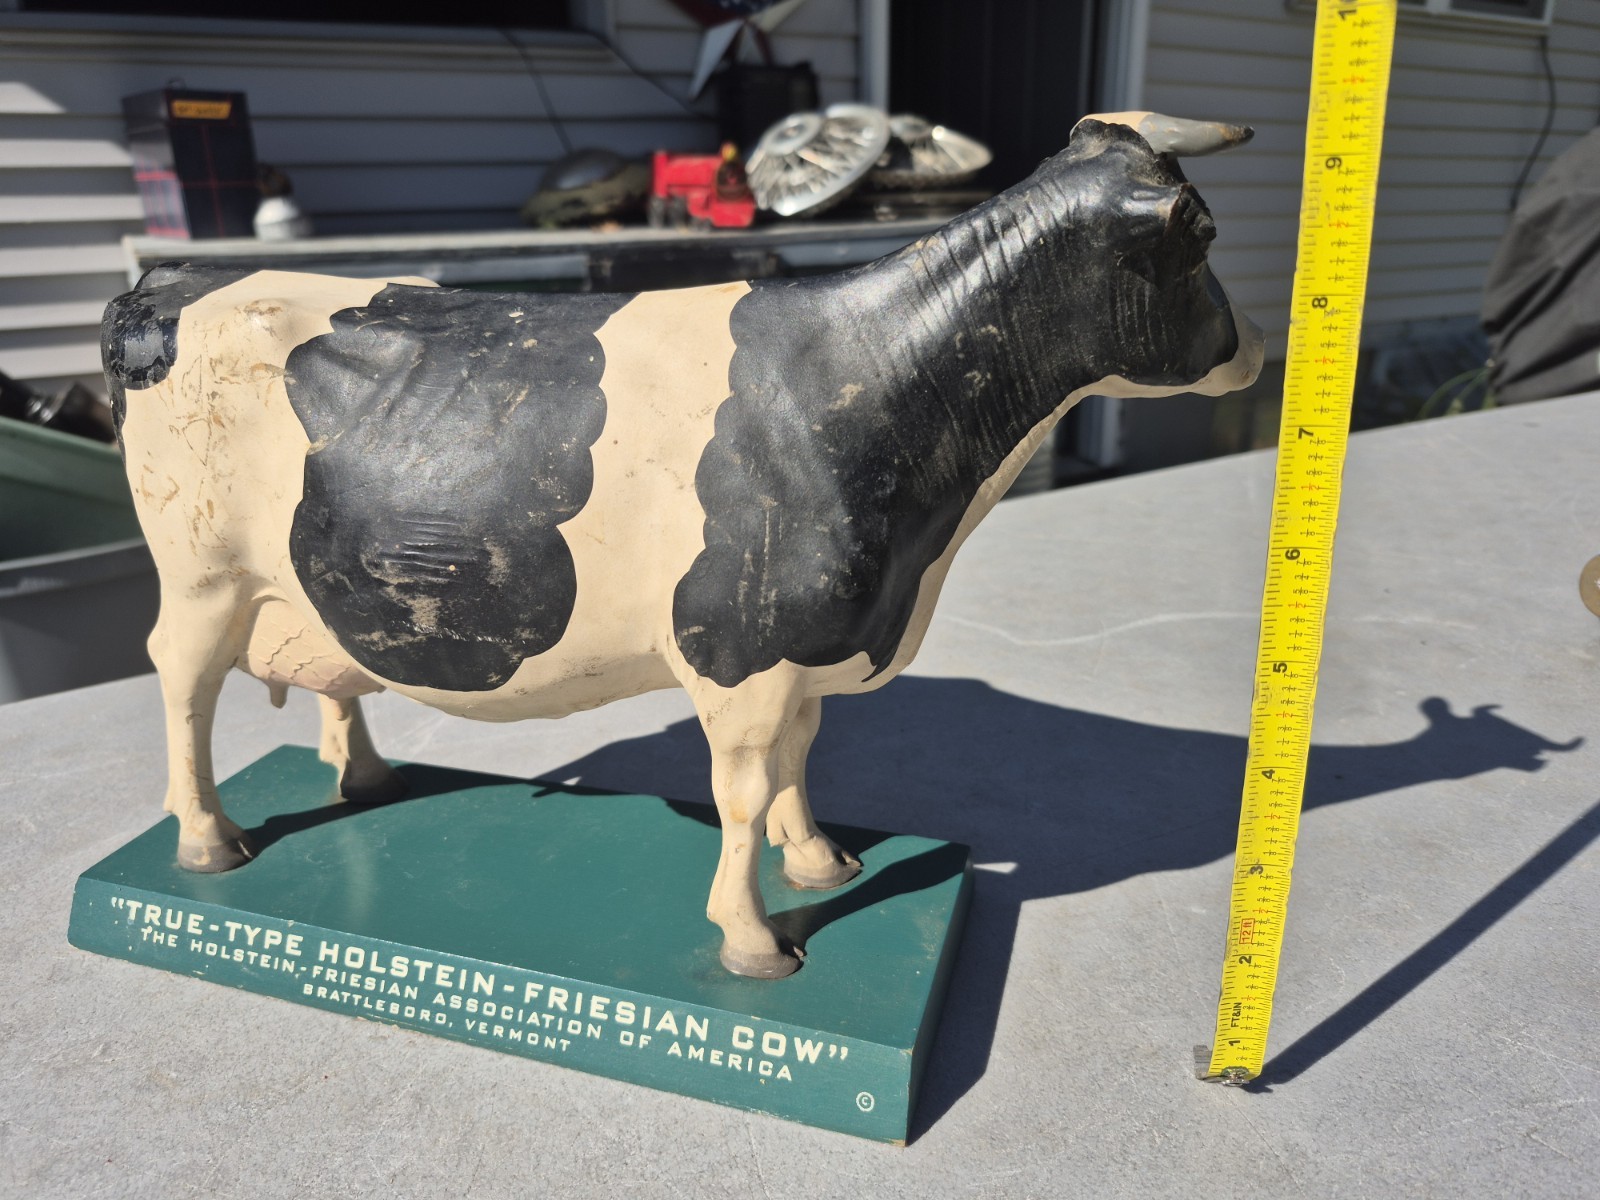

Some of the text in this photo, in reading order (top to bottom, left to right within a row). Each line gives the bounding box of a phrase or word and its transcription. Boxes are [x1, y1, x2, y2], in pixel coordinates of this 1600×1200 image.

[1326, 157, 1342, 170] 9
[1312, 297, 1327, 308] 8
[1298, 428, 1314, 439] 7
[1285, 549, 1300, 560] 6
[1273, 663, 1287, 673] 5
[1262, 769, 1275, 779] 4
[1250, 865, 1263, 875] 3
[1242, 929, 1251, 941] 12
[1239, 956, 1252, 964] 2
[318, 941, 709, 1041] HOLSTEIN-FRIESIAN
[140, 927, 792, 1082] THE HOLSTEIN-FRIESIAN ASSOCIATION OF AMERICA
[303, 983, 571, 1053] BRATTLEBORO, VERMONT
[1231, 1002, 1242, 1027] FT&IN
